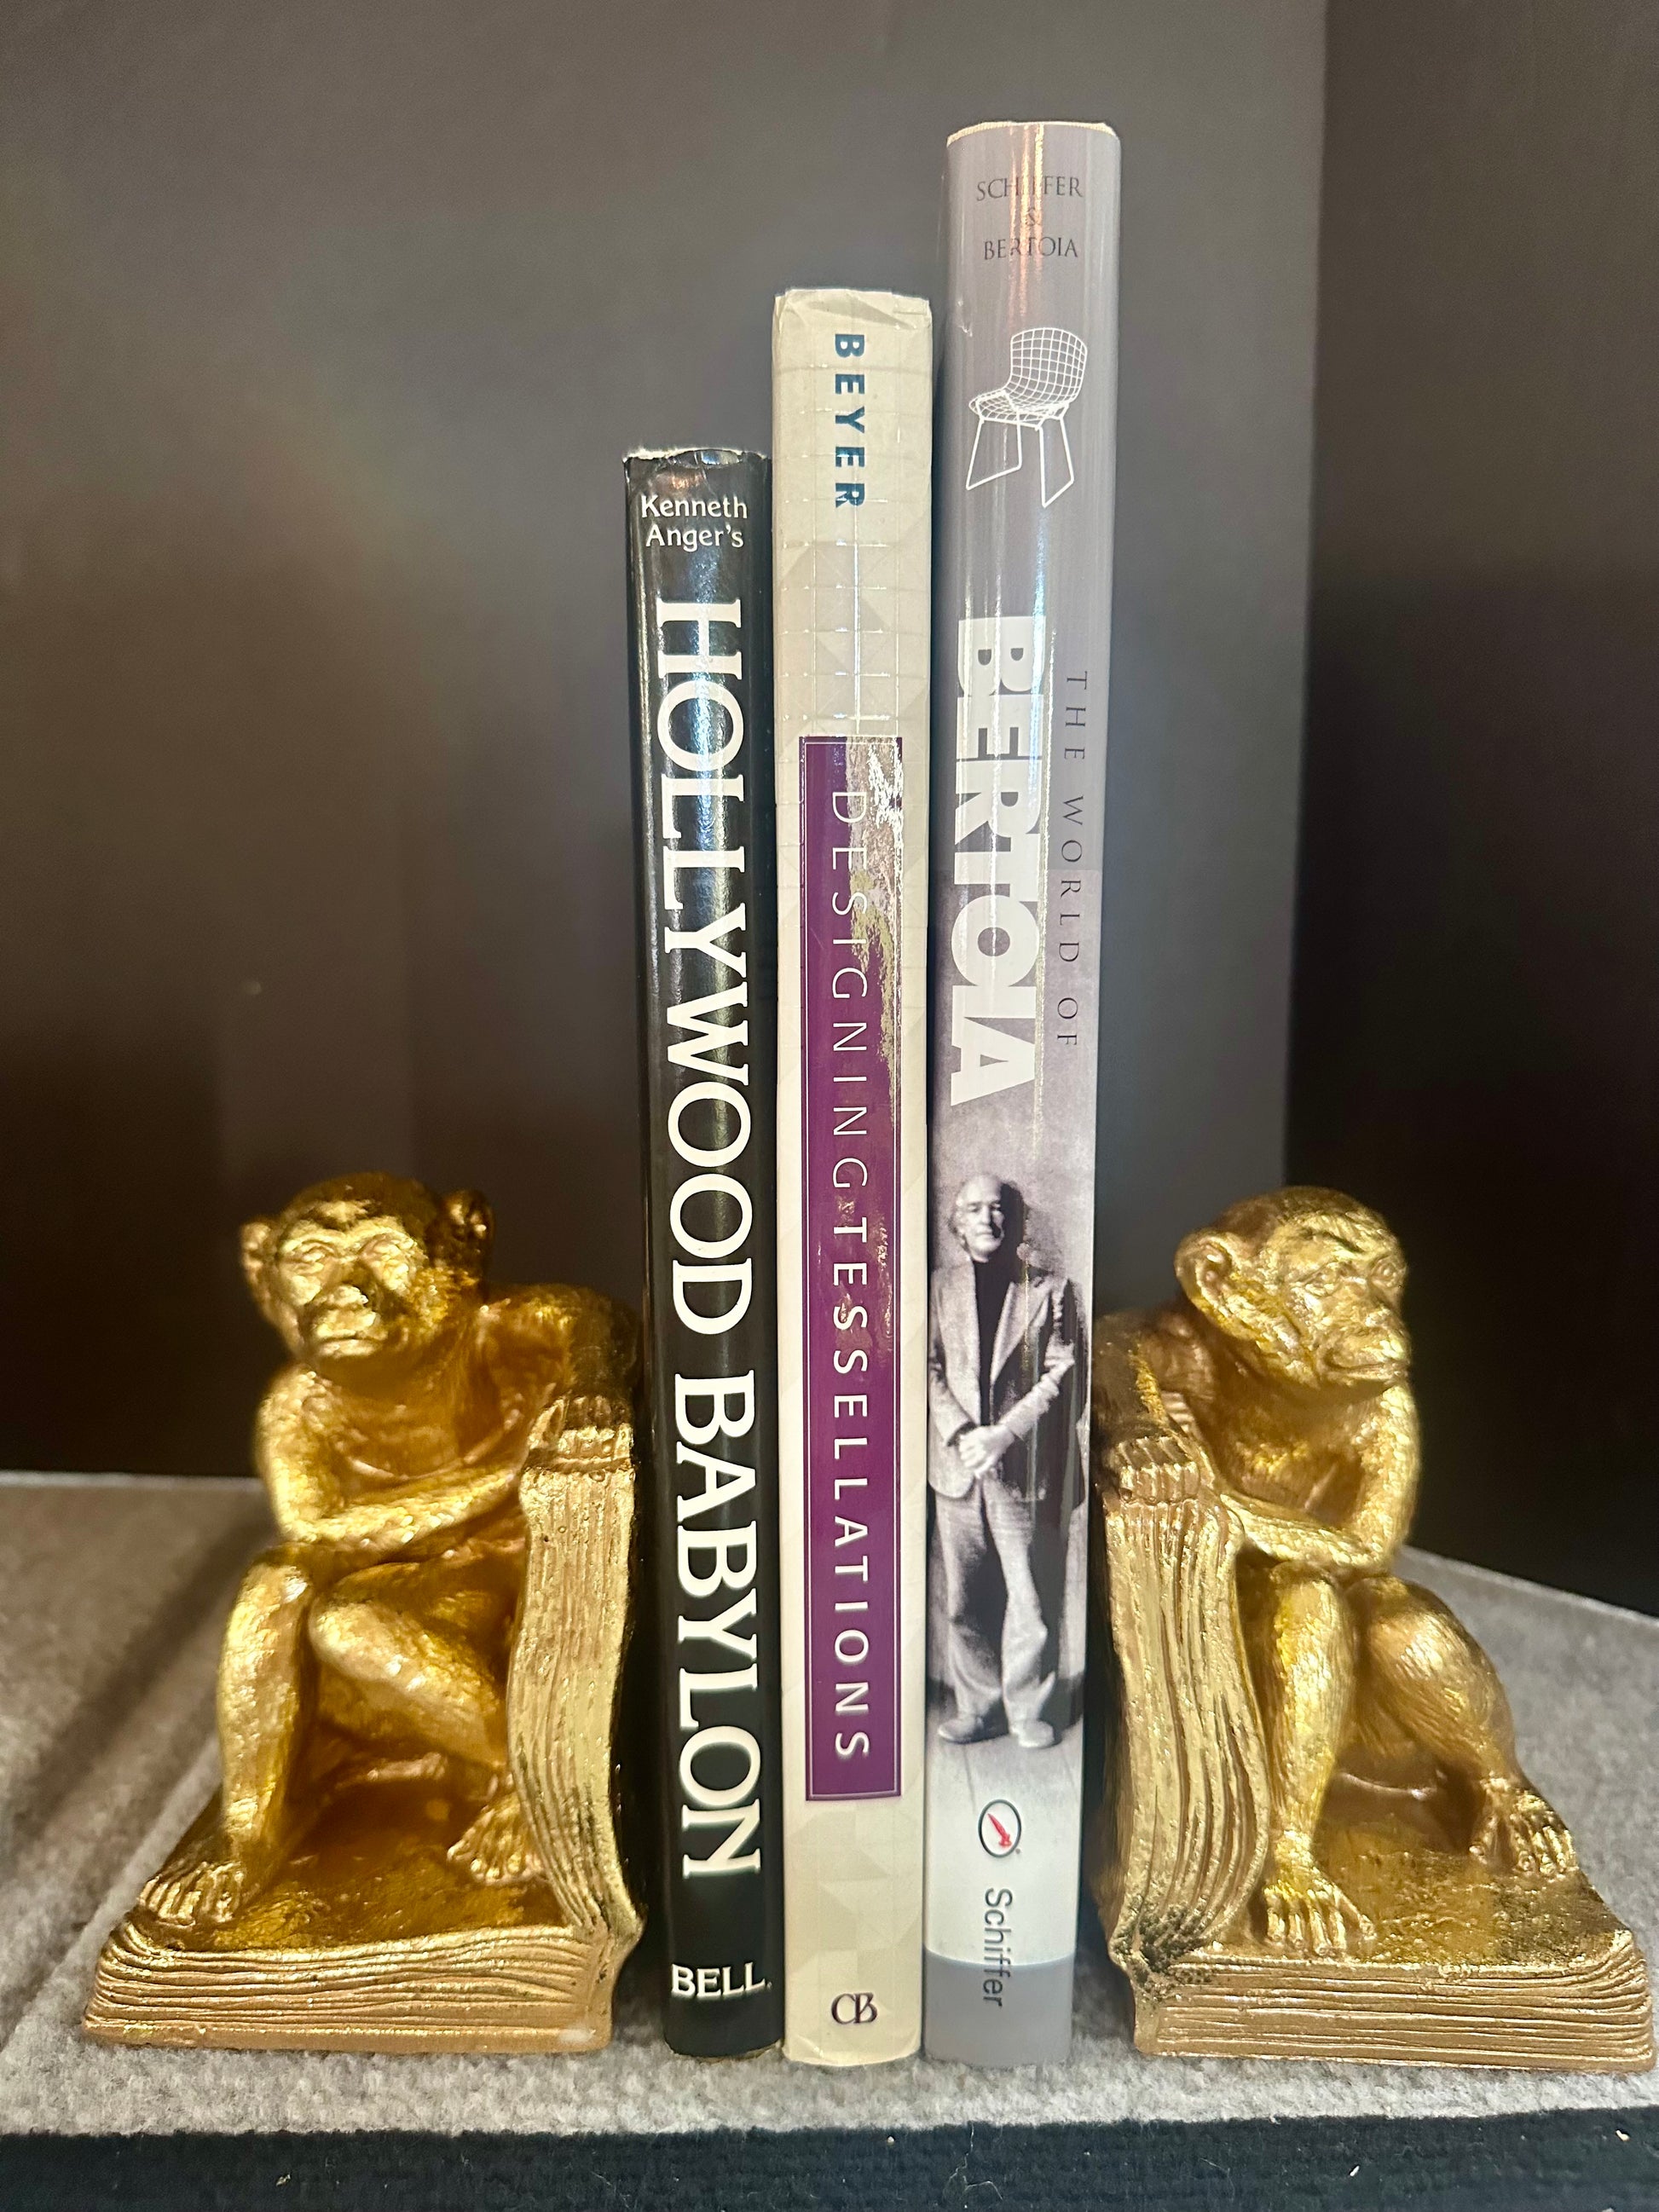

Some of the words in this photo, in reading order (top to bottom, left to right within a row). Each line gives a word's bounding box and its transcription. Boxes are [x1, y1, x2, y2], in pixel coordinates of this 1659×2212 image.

[976, 176, 1084, 201] SCHFER
[984, 236, 1078, 260] BERTOIA
[835, 333, 865, 508] BEYER
[641, 494, 748, 519] Kenneth
[645, 523, 744, 552] Anger's
[1063, 670, 1088, 760] THE
[950, 615, 1046, 1106] BERTOIA
[1058, 794, 1084, 964] WORLD
[656, 598, 752, 1335] HOLLYWOOD
[832, 791, 869, 1189] DESIGNING
[1055, 994, 1079, 1047] OF
[832, 1217, 869, 1759] TESSELLATIONS
[674, 1370, 762, 1879] BABYLON
[982, 1887, 1014, 2008] Schiffer
